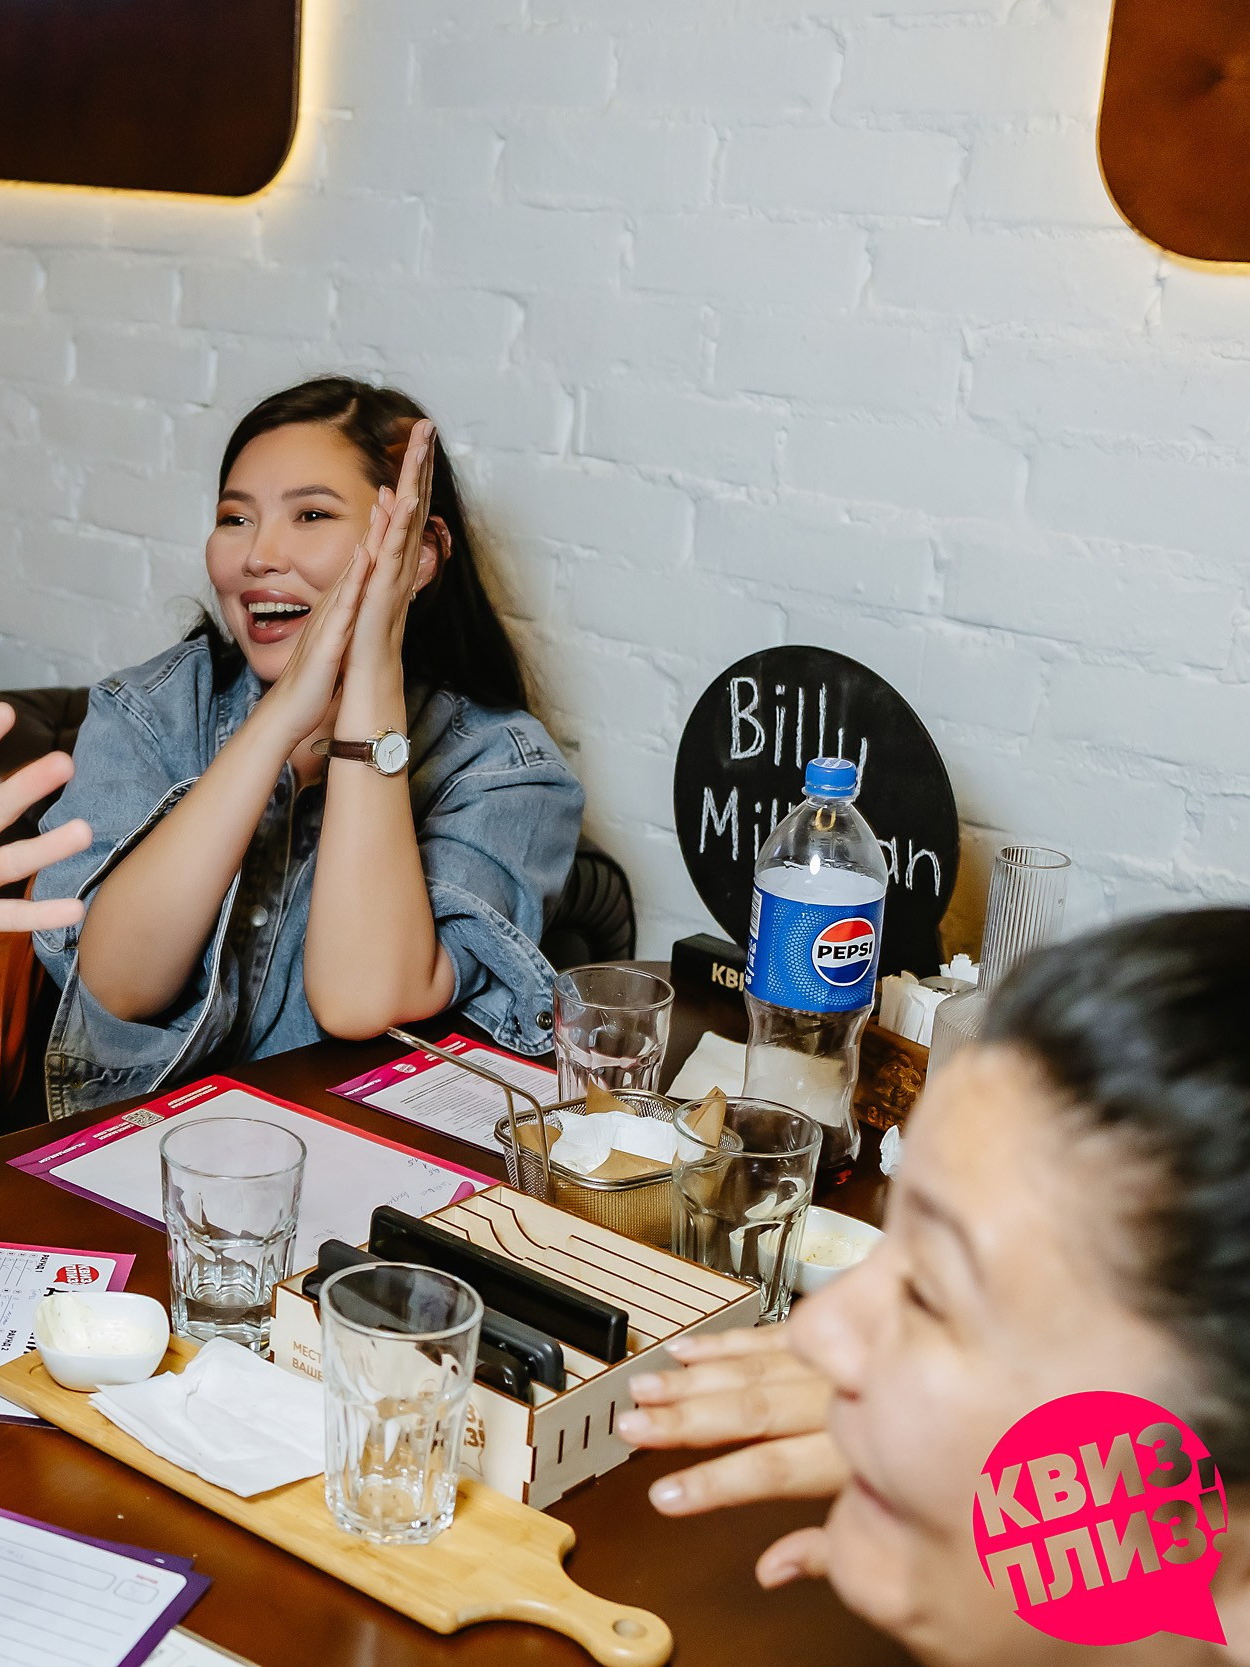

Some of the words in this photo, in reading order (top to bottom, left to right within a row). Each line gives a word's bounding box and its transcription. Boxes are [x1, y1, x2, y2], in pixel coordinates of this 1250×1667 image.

[699, 787, 941, 896] Milan
[817, 940, 873, 960] PEPSI
[35, 1254, 50, 1269] РАУНД
[1, 1329, 17, 1346] РАУНД
[292, 1341, 323, 1363] МЕСТ
[292, 1357, 324, 1382] ВАШЕ
